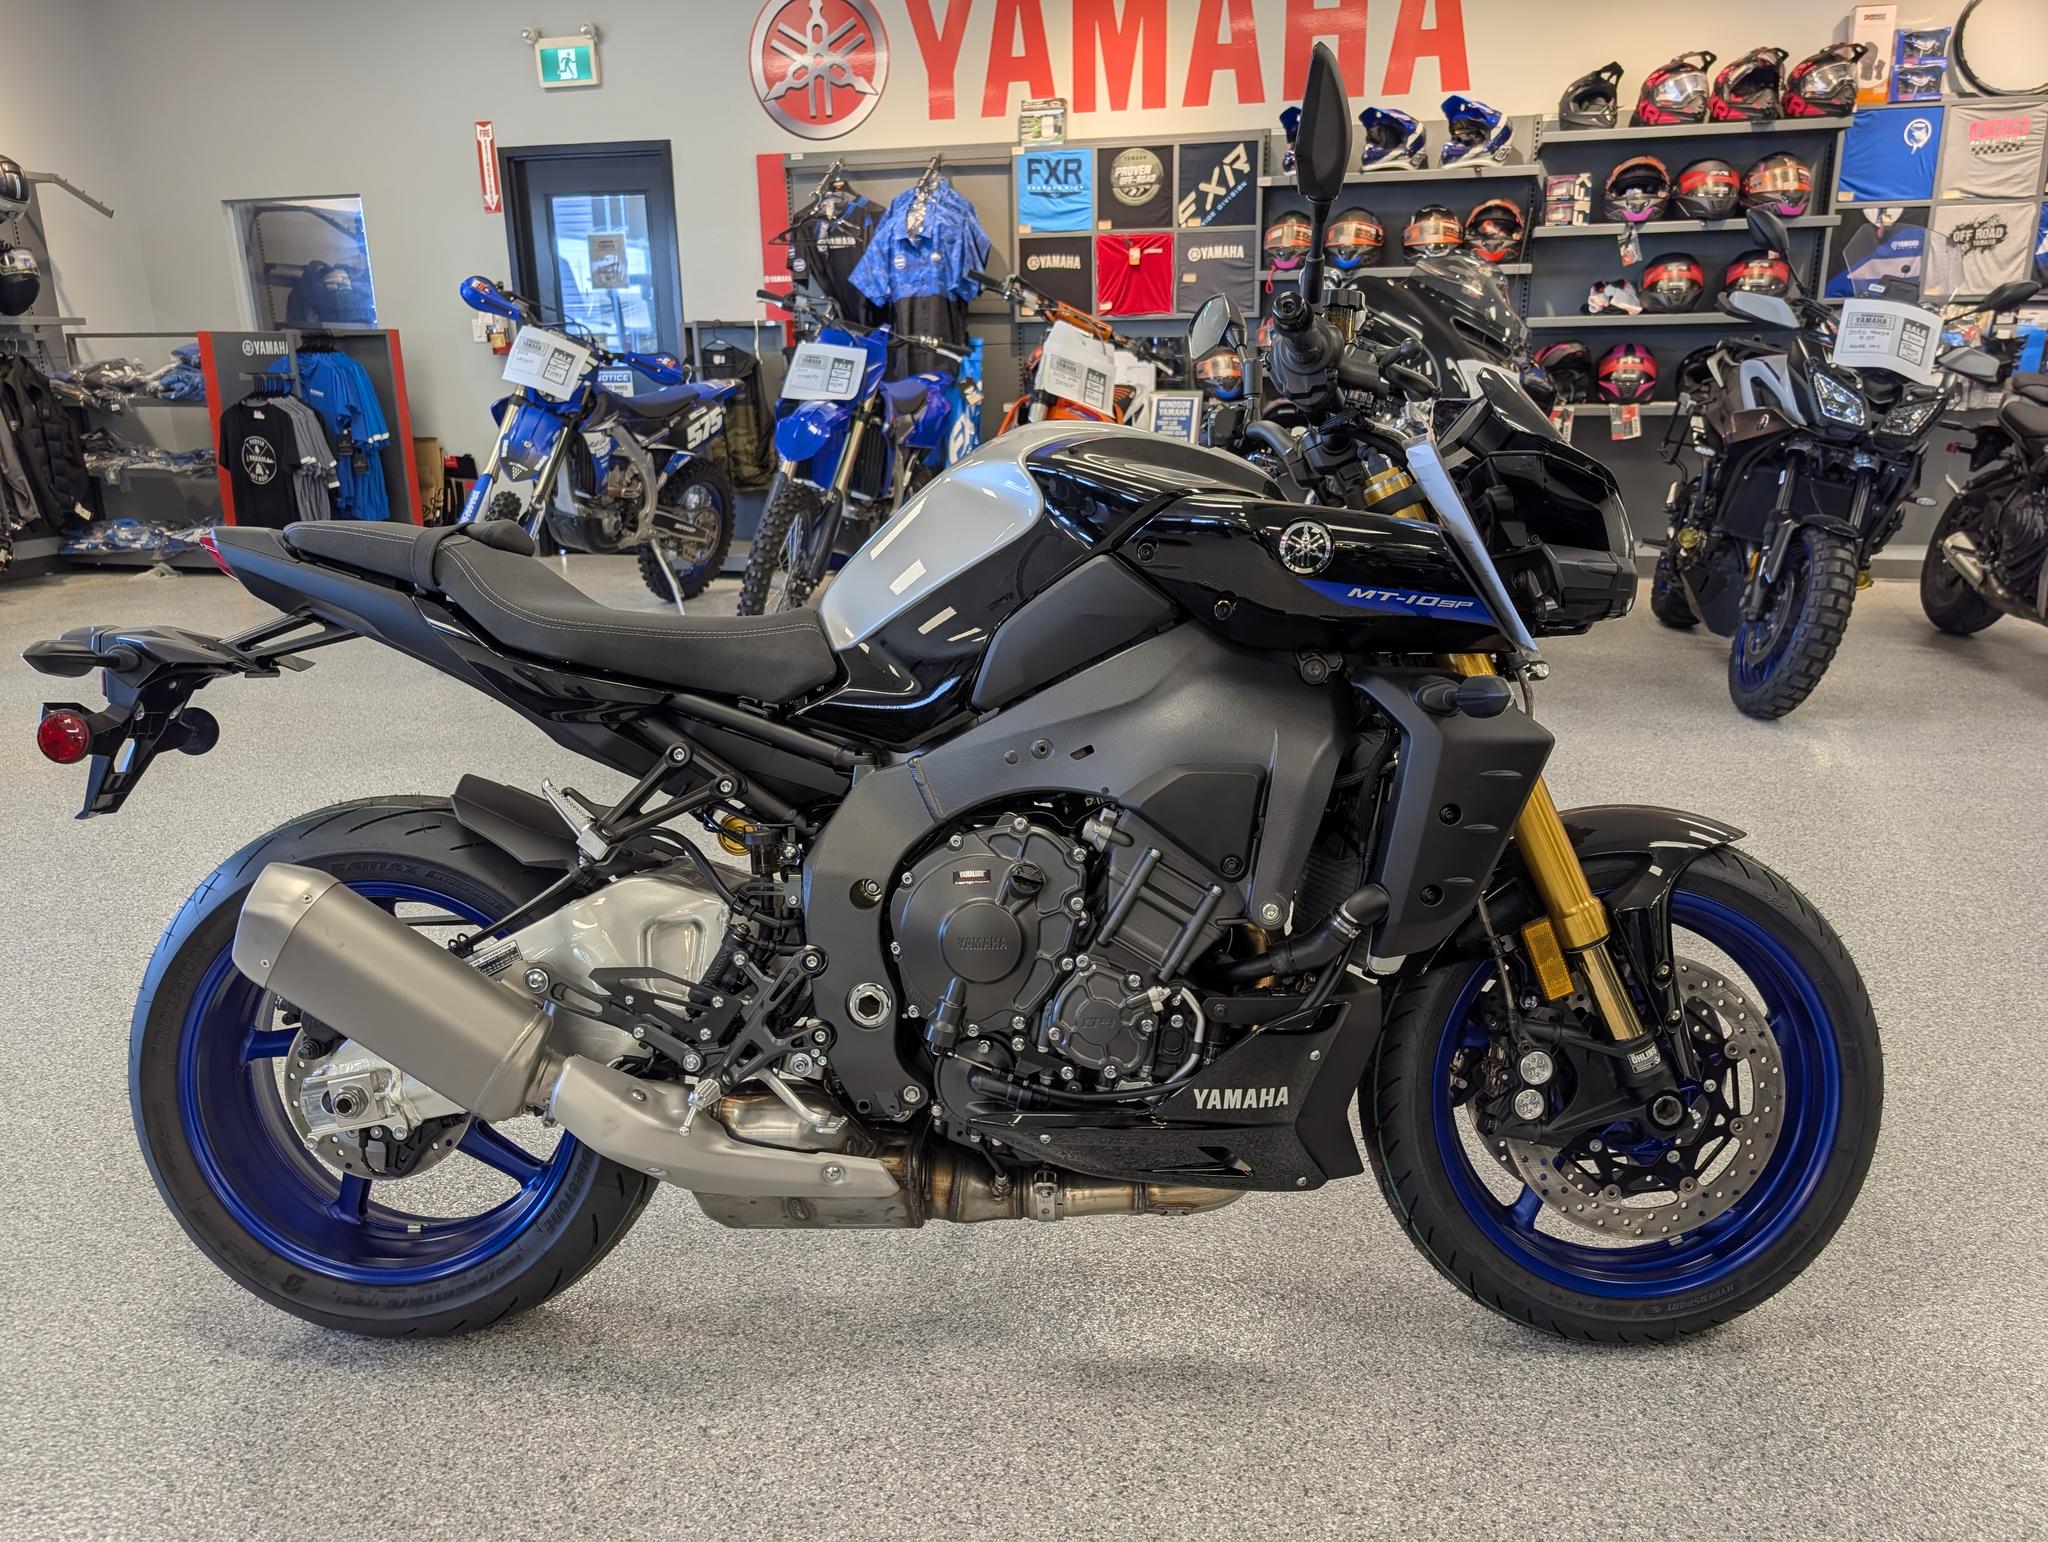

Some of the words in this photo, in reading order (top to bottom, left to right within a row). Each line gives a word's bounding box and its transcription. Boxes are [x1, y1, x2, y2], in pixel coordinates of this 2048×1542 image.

[905, 0, 1471, 120] YAMAHA
[479, 128, 491, 138] FIRE
[1026, 158, 1082, 185] FXR
[1115, 164, 1152, 177] PROVEN
[1118, 173, 1157, 186] OFF-ROAD
[1178, 142, 1251, 228] FXR
[1953, 228, 1974, 242] OFF
[1975, 227, 2004, 241] ROAD
[1201, 245, 1244, 260] YAMAHA
[1039, 255, 1082, 270] YAMAHA
[1855, 317, 1888, 326] YAMAHA
[1904, 323, 1928, 338] SALE
[552, 351, 573, 364] SALE
[833, 362, 853, 371] SALE
[1159, 400, 1192, 409] WINDSOR
[1158, 408, 1190, 417] YAMAHA
[687, 408, 725, 450] 575
[959, 869, 988, 878] YAMALUBE
[958, 936, 1008, 951] YAMAHA
[1193, 1086, 1289, 1110] YAMAHA
